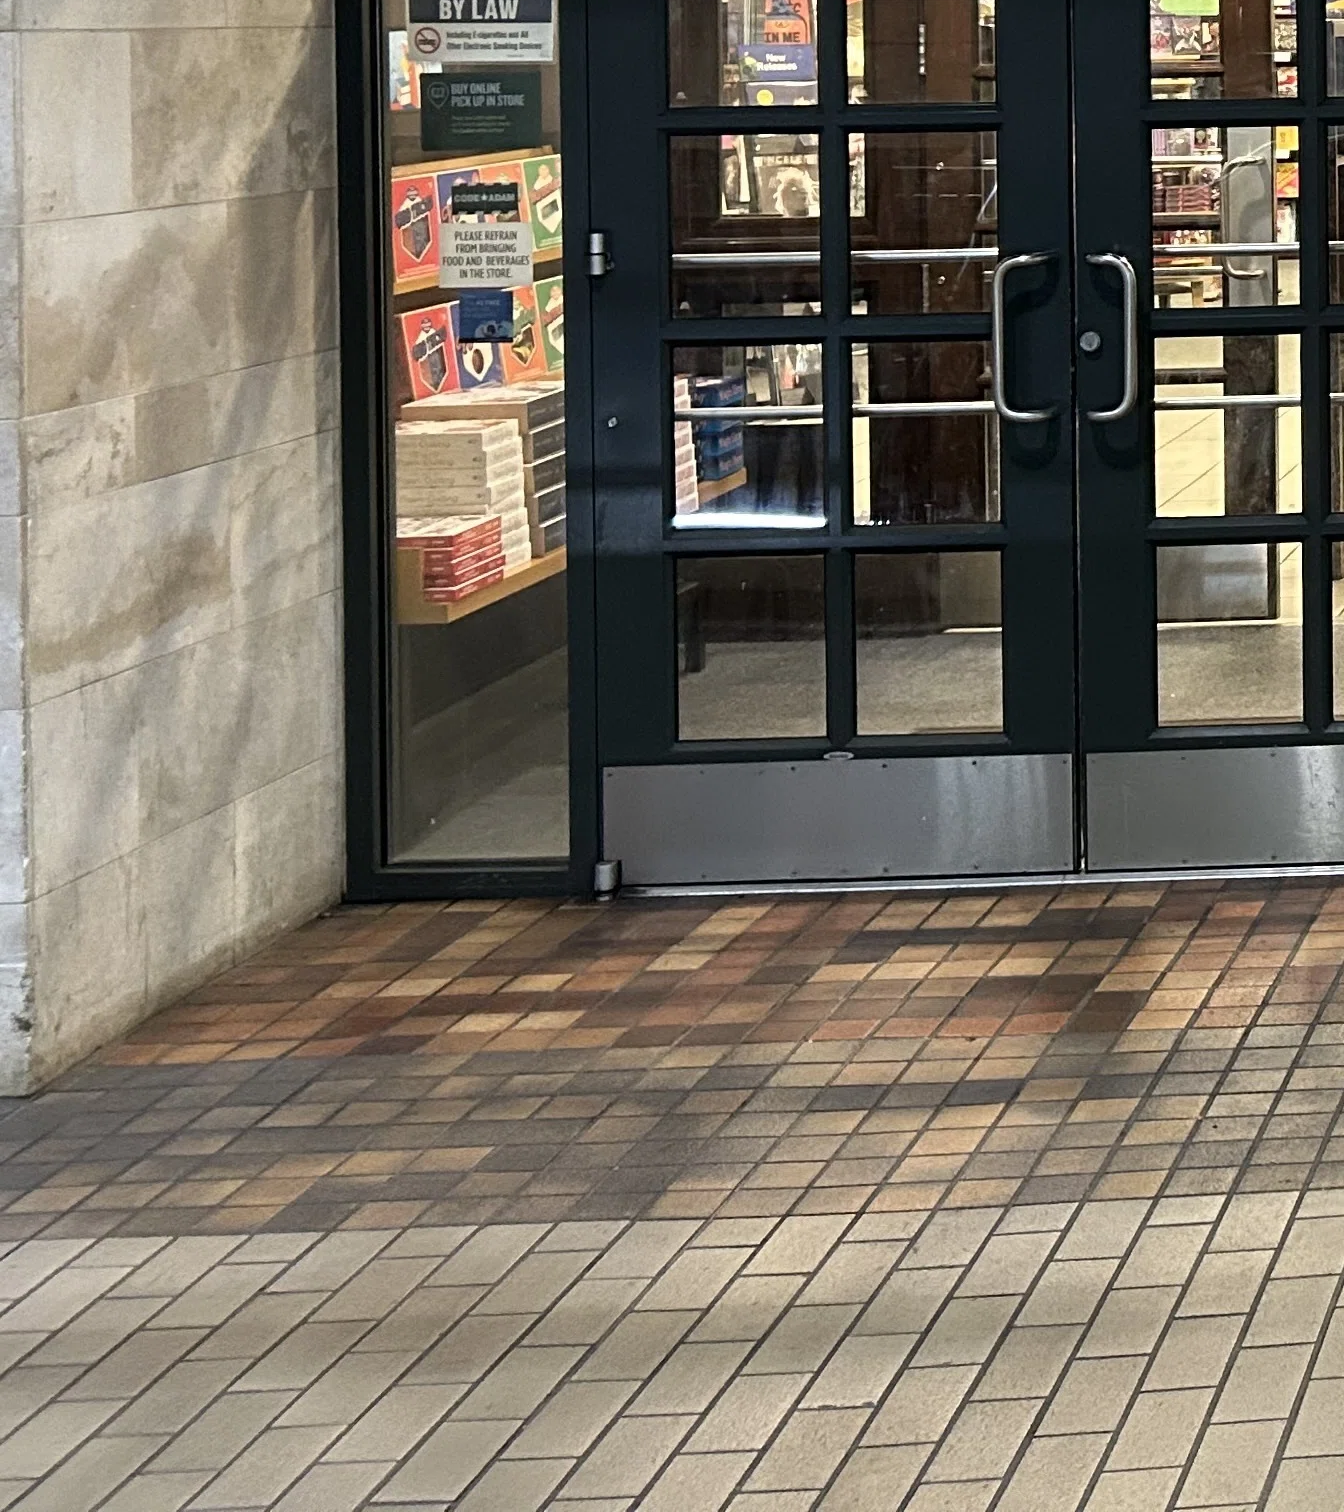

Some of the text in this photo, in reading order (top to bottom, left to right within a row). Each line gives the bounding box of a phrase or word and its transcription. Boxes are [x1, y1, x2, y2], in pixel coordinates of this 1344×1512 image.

[439, 0, 519, 20] BY LAW
[451, 82, 501, 94] BUY ONLINE
[451, 94, 525, 107] PICK UP IN STORE
[454, 230, 517, 241] PLEASE REFRAIN
[455, 243, 517, 254] FROM BRINGING
[442, 255, 529, 266] FOOD AND BEVERAGES
[459, 269, 468, 279] IN
[470, 269, 485, 278] THE
